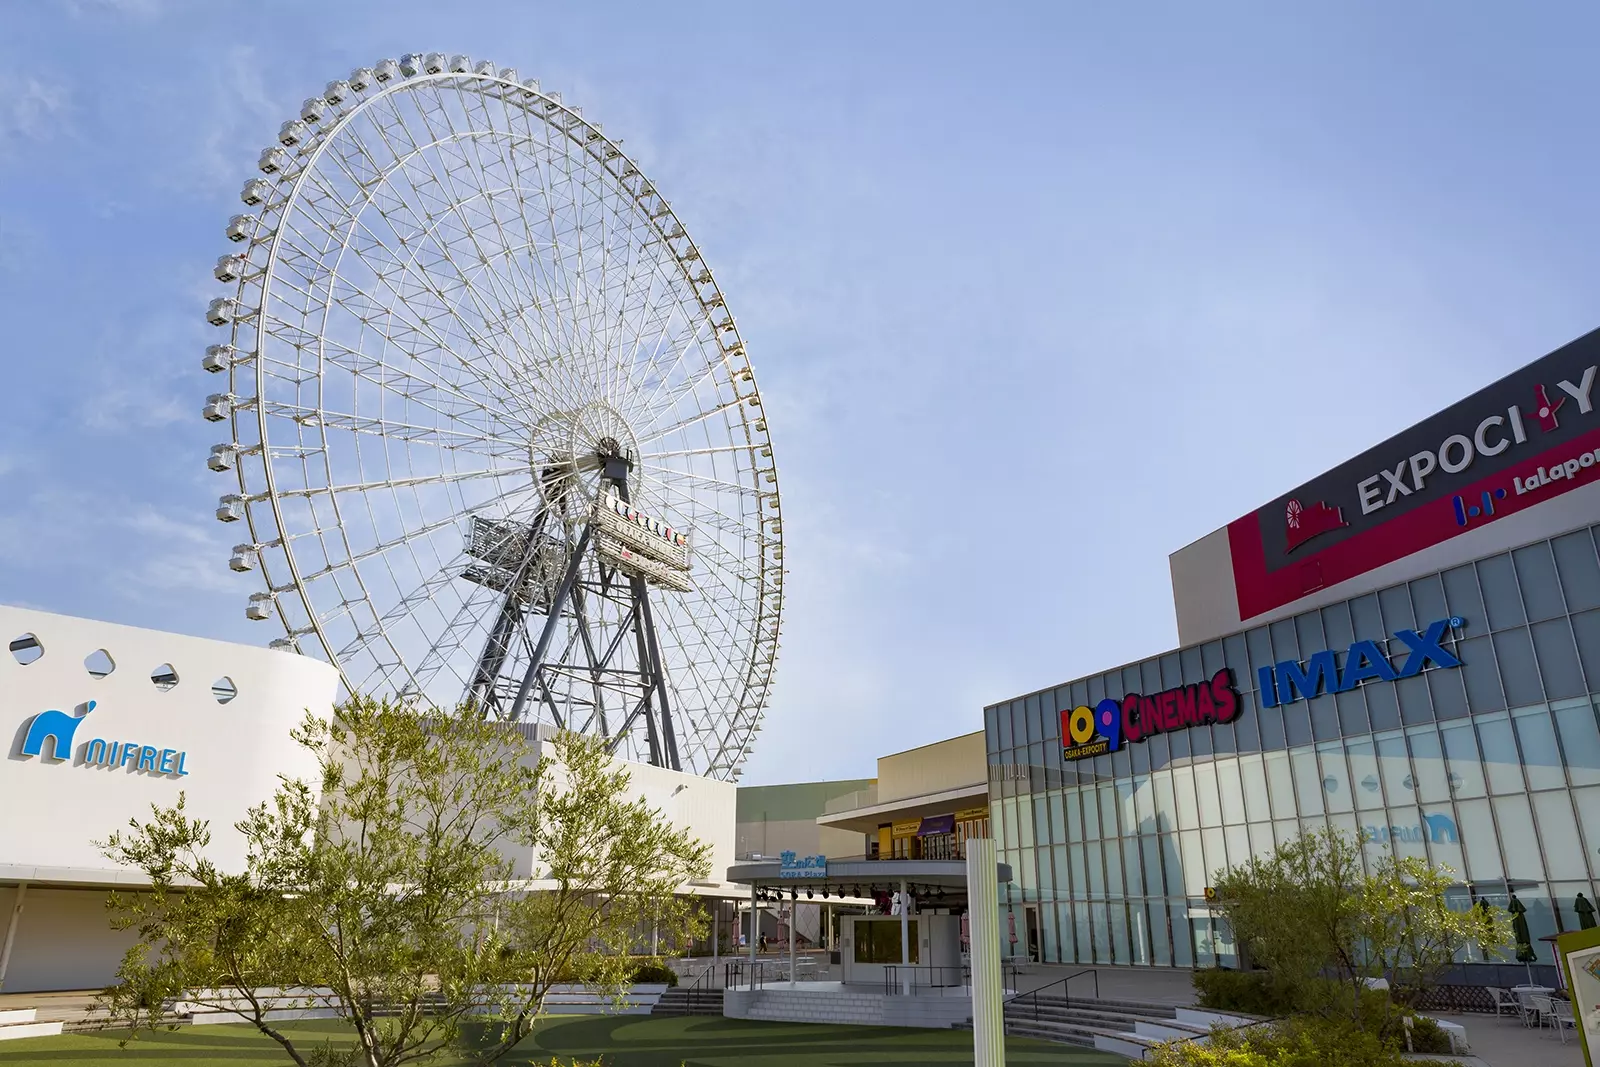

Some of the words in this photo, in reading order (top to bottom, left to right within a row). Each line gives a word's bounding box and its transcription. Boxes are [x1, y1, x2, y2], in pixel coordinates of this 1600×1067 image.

[1060, 698, 1121, 750] 109
[1122, 667, 1237, 743] CINEMAS
[86, 738, 189, 776] NIFREL
